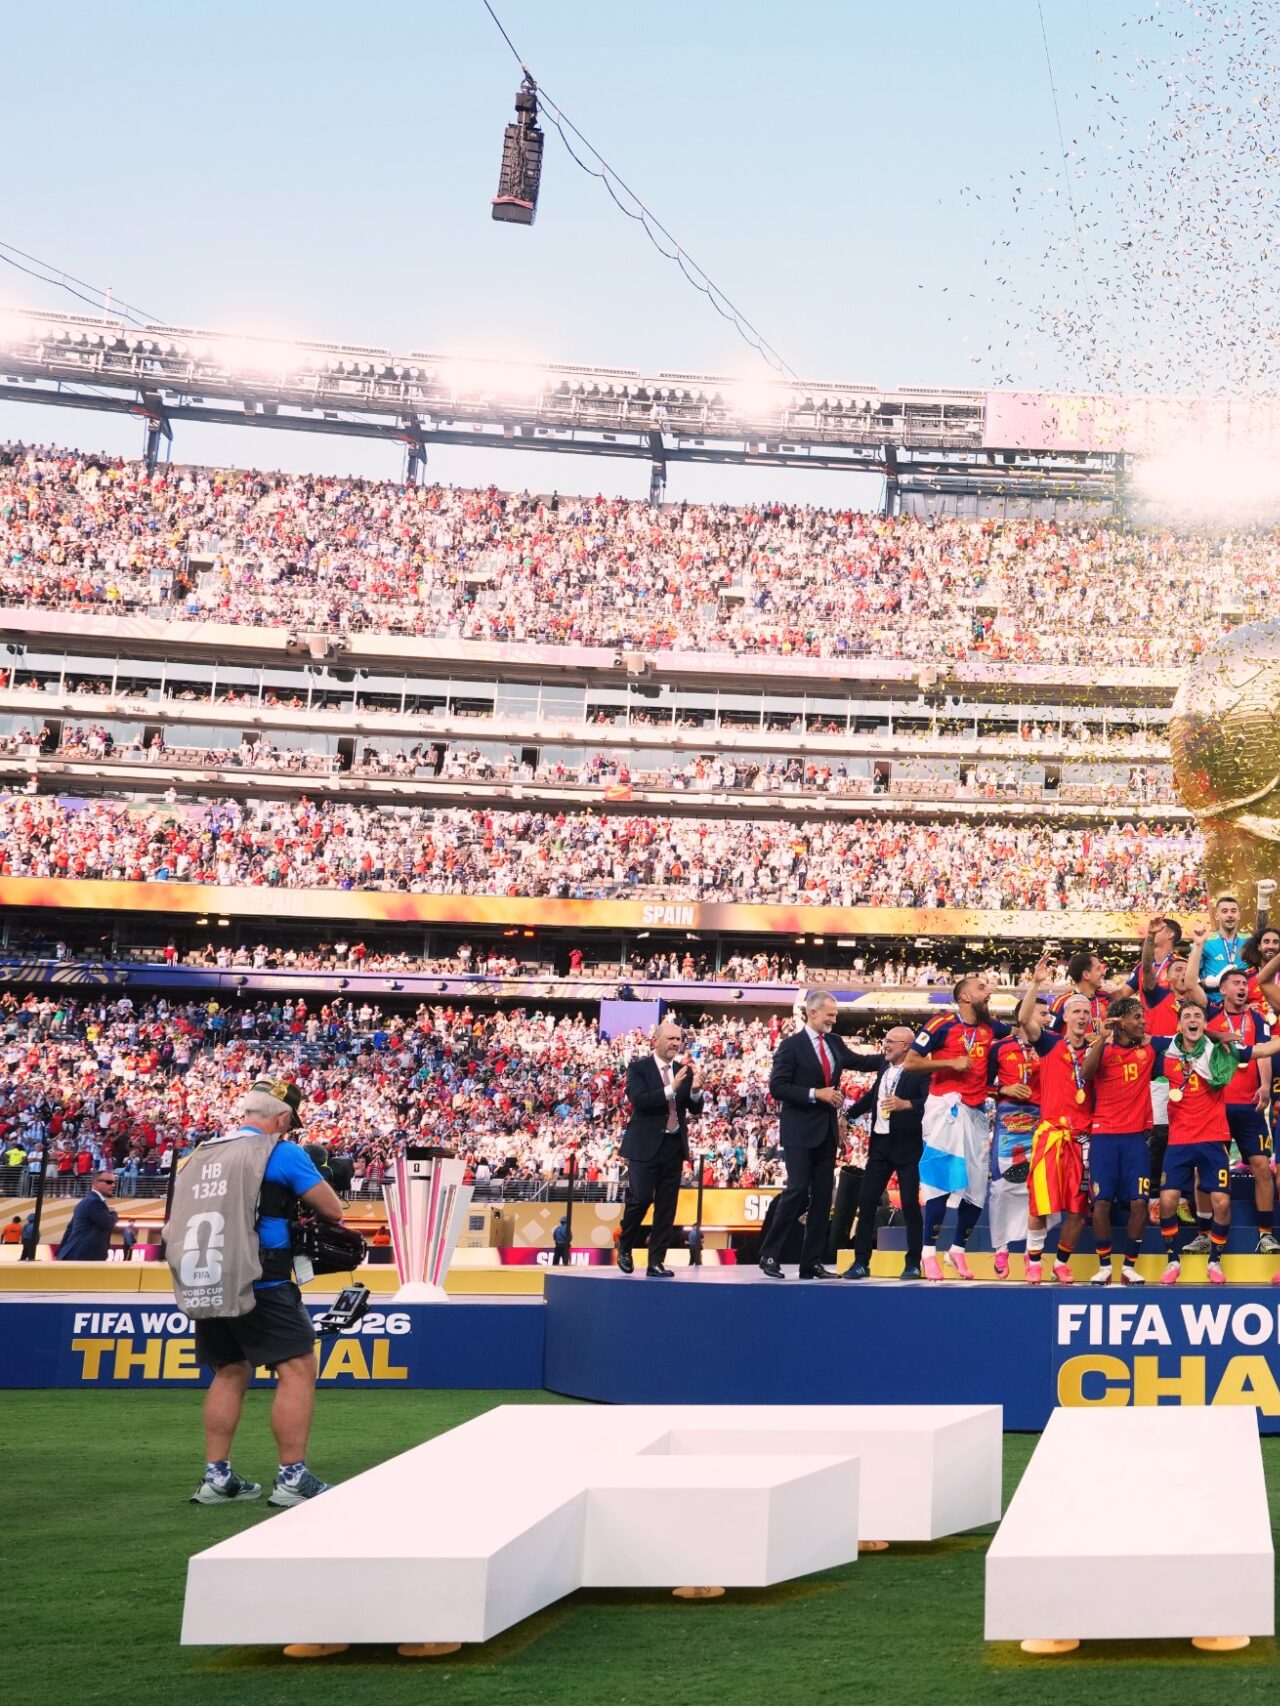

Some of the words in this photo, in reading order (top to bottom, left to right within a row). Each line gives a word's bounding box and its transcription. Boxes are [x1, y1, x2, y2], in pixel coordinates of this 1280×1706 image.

[643, 905, 694, 925] SPAIN
[1122, 1063, 1139, 1082] 19
[1188, 1073, 1199, 1092] 9
[201, 1162, 223, 1180] HB
[1218, 1168, 1228, 1188] 9
[191, 1180, 228, 1200] 1328
[1138, 1176, 1151, 1196] 19
[192, 1271, 211, 1281] FIFA
[206, 1287, 224, 1296] CUP
[183, 1296, 224, 1309] 2026
[73, 1312, 136, 1335] FIFA
[1057, 1303, 1172, 1346] FIFA
[71, 1338, 200, 1380] THE
